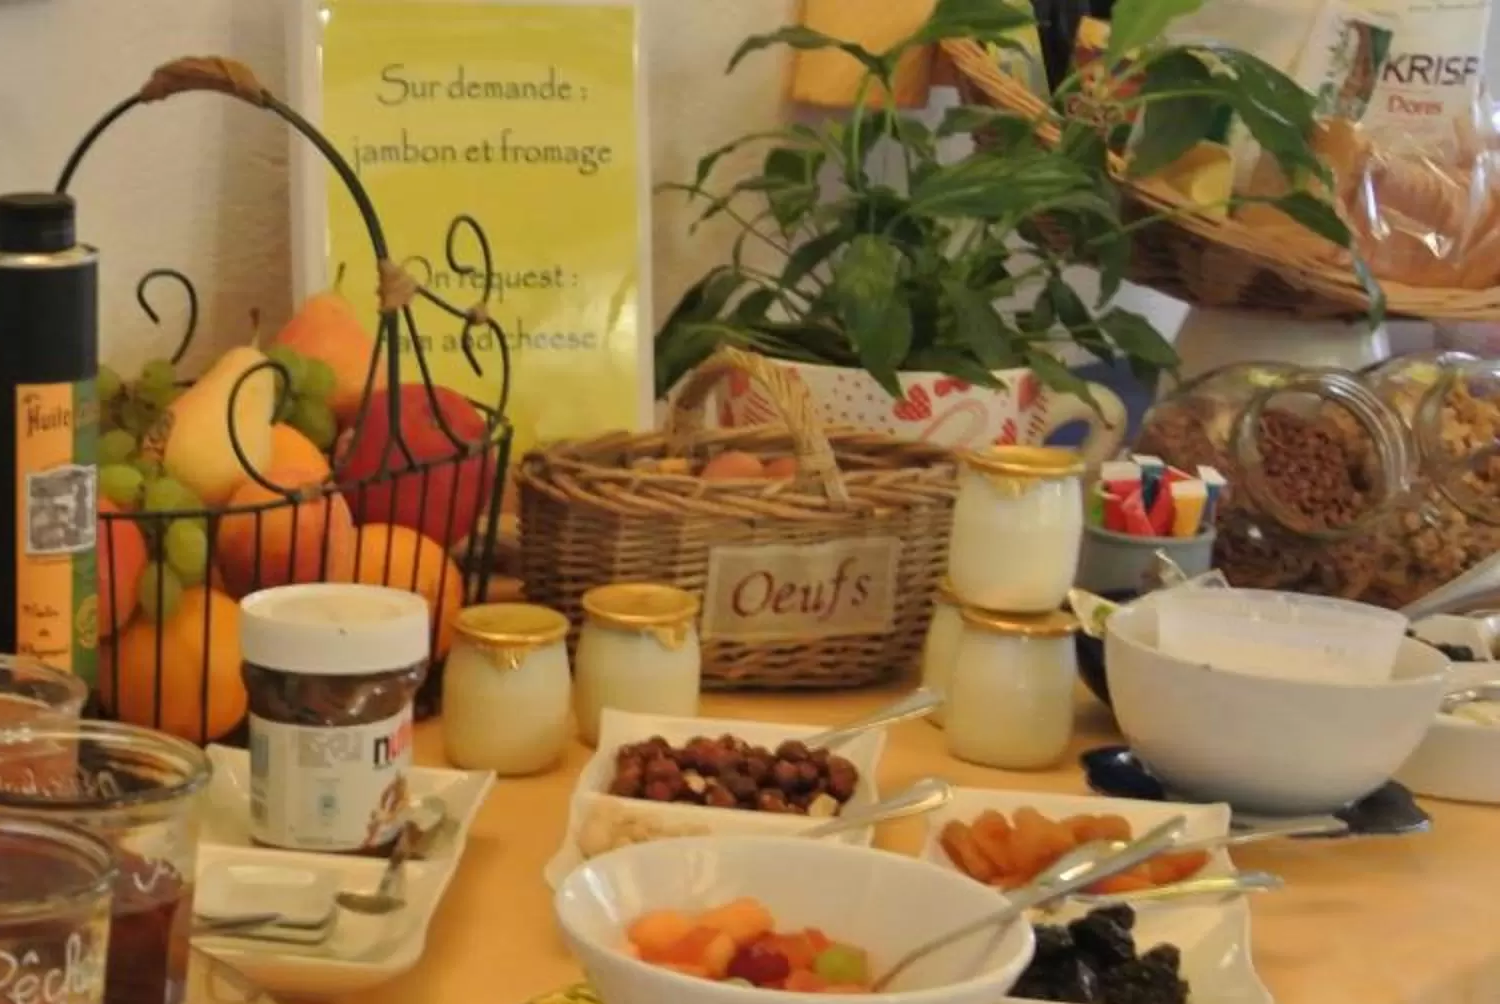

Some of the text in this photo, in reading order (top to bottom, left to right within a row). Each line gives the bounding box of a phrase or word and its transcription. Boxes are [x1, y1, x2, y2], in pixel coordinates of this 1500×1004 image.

[377, 63, 441, 106] Sur
[448, 65, 572, 101] demande
[351, 129, 612, 176] jambon et fromage
[731, 555, 872, 623] Oeufs
